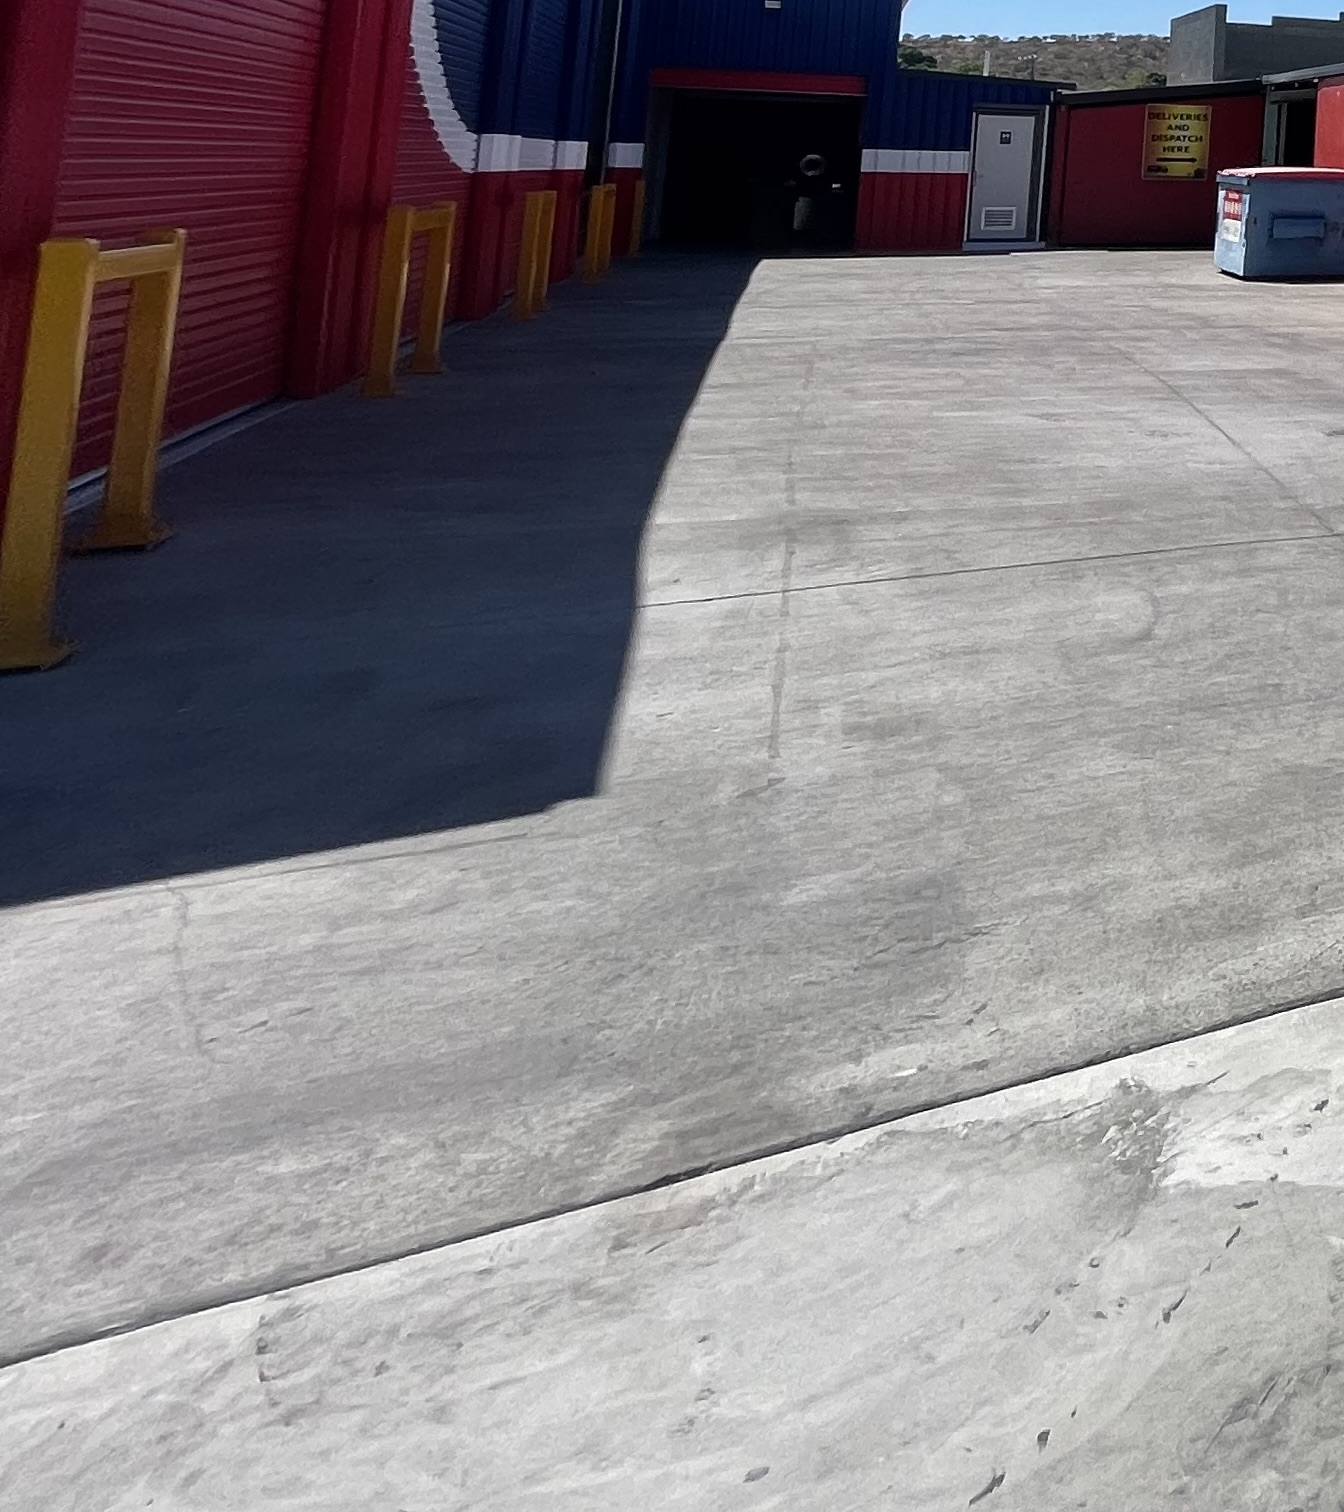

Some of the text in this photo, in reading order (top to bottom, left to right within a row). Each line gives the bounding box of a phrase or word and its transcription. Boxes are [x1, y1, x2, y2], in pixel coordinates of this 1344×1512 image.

[1147, 112, 1209, 122] DELIVERIES
[1167, 124, 1190, 132] AND
[1151, 135, 1204, 143] DISPATCH
[1162, 145, 1190, 154] HERE
